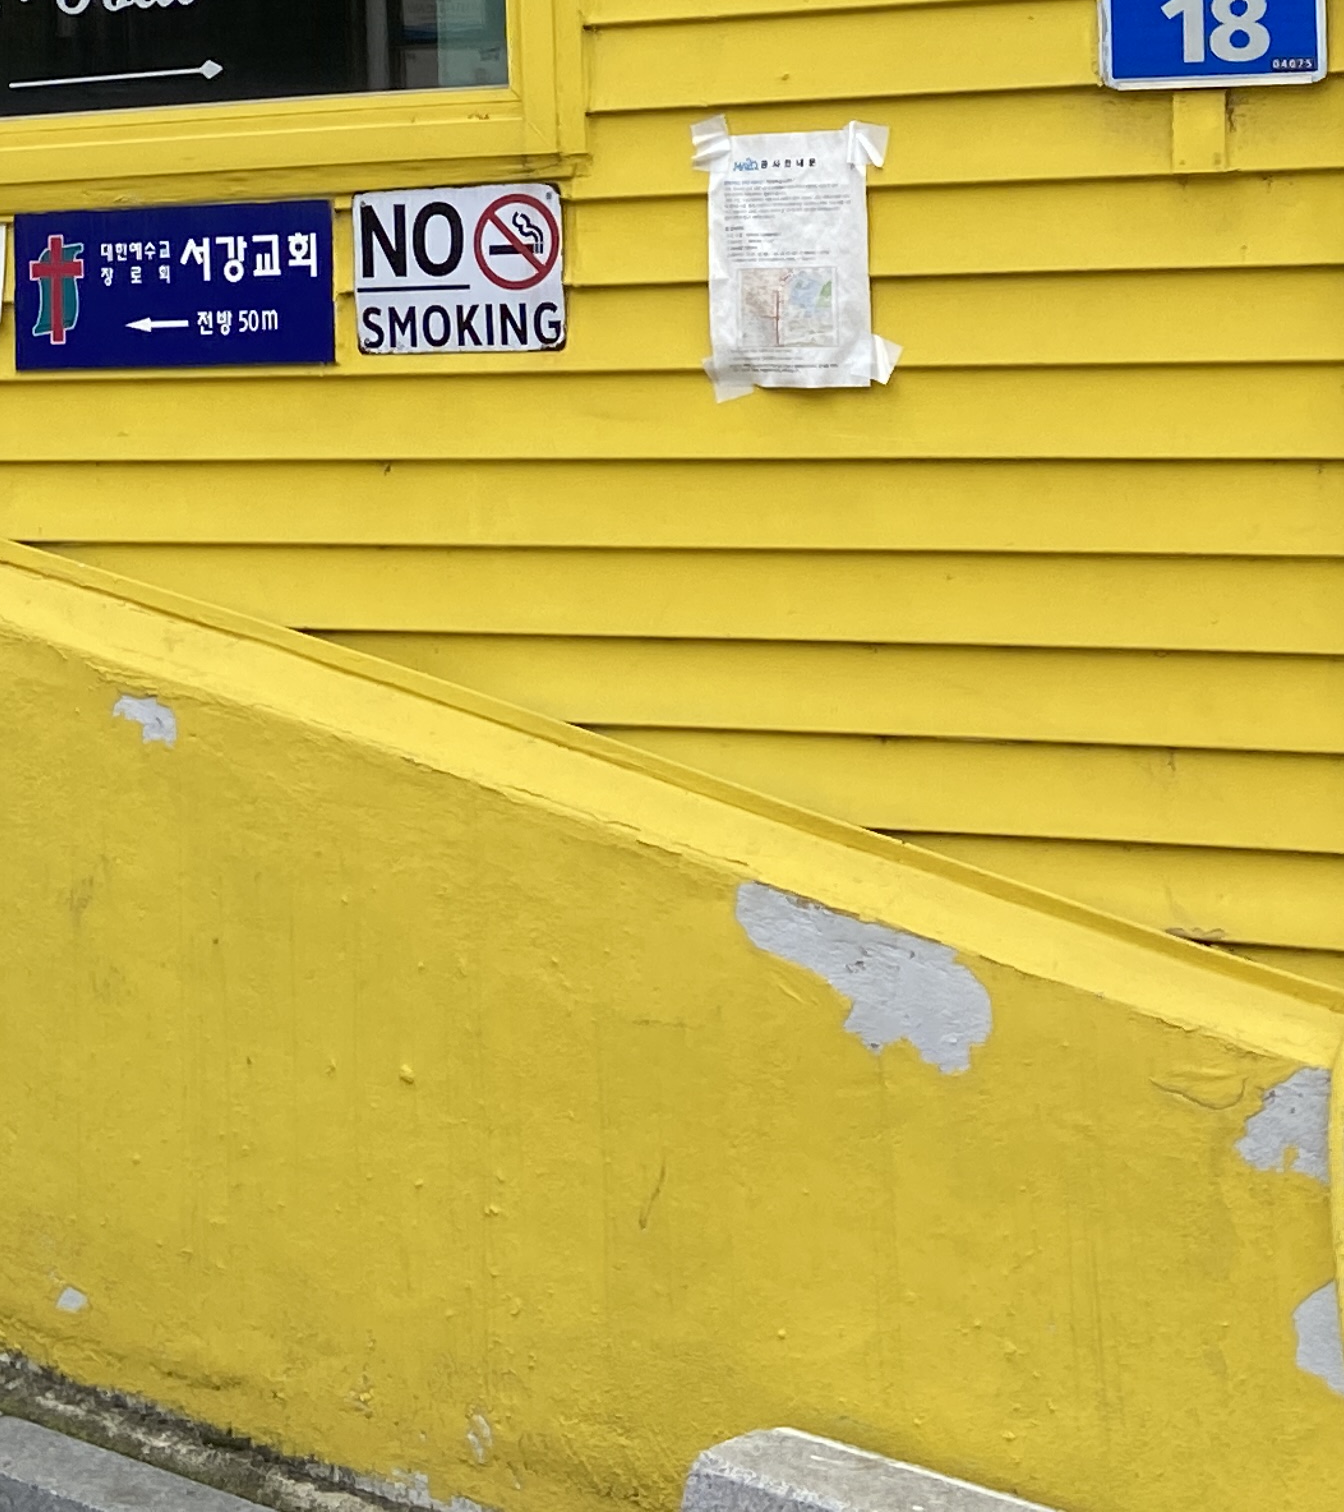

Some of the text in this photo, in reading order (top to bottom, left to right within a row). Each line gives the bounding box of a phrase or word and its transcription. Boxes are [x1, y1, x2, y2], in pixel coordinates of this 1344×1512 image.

[100, 240, 171, 262] 대한예수교
[180, 232, 318, 283] 서강교회
[360, 201, 463, 278] NO
[197, 309, 279, 336] 전방 50m
[359, 301, 565, 350] SMOKING
